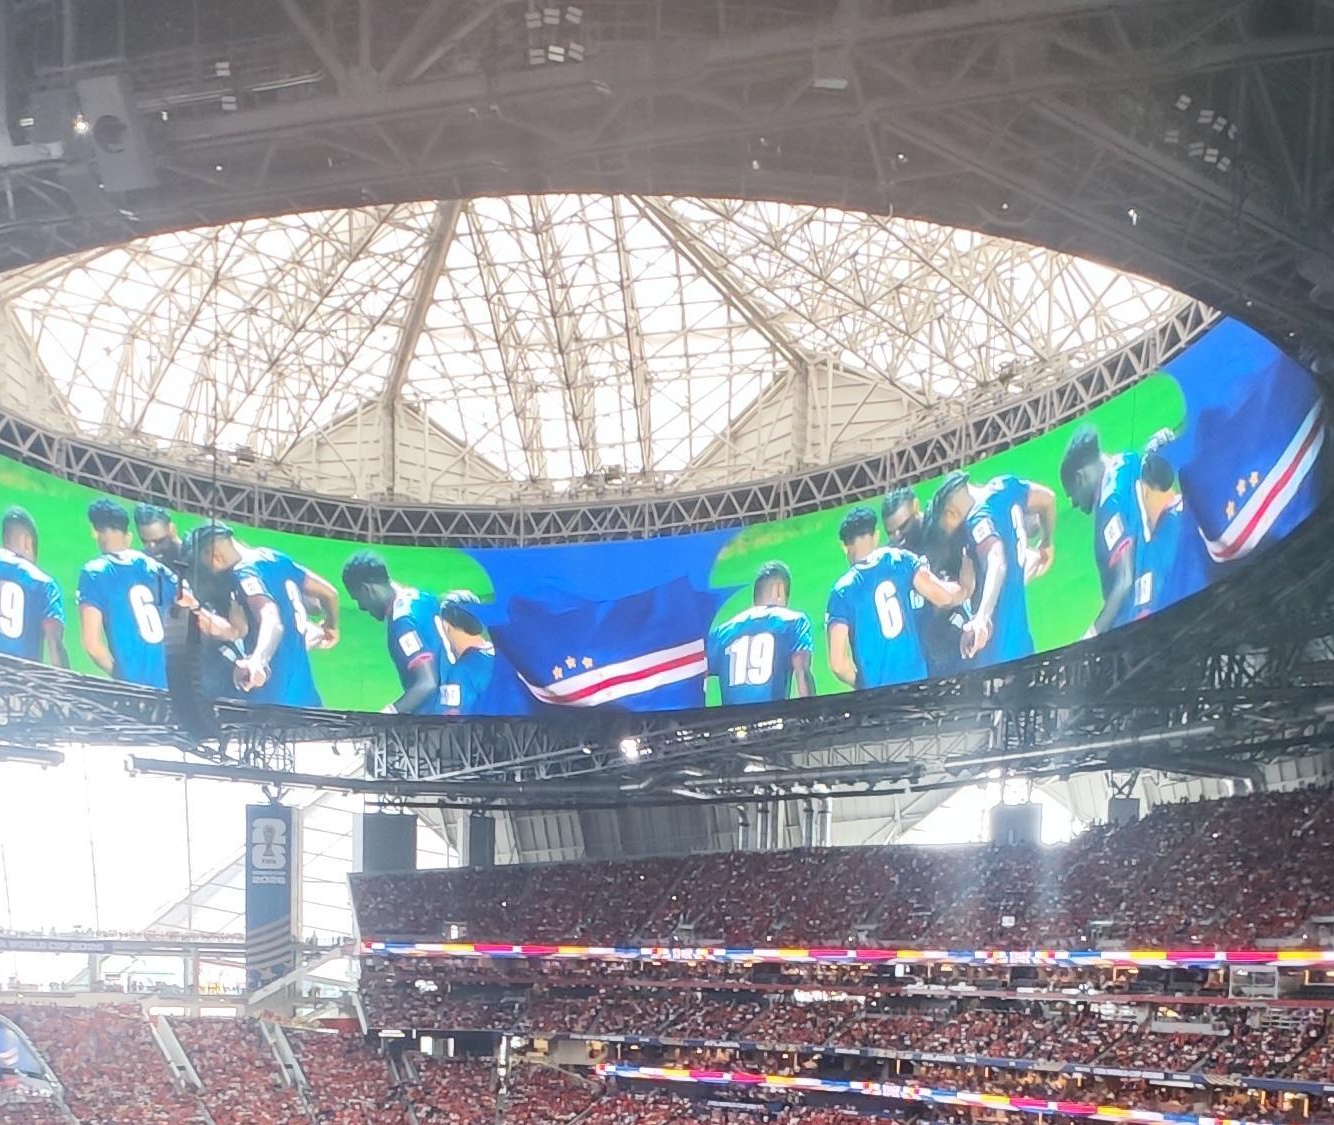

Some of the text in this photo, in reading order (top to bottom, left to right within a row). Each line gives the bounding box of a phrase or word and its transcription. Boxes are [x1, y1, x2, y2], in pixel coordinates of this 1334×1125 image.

[129, 584, 165, 644] 6
[874, 580, 904, 639] 6
[724, 632, 775, 686] 19
